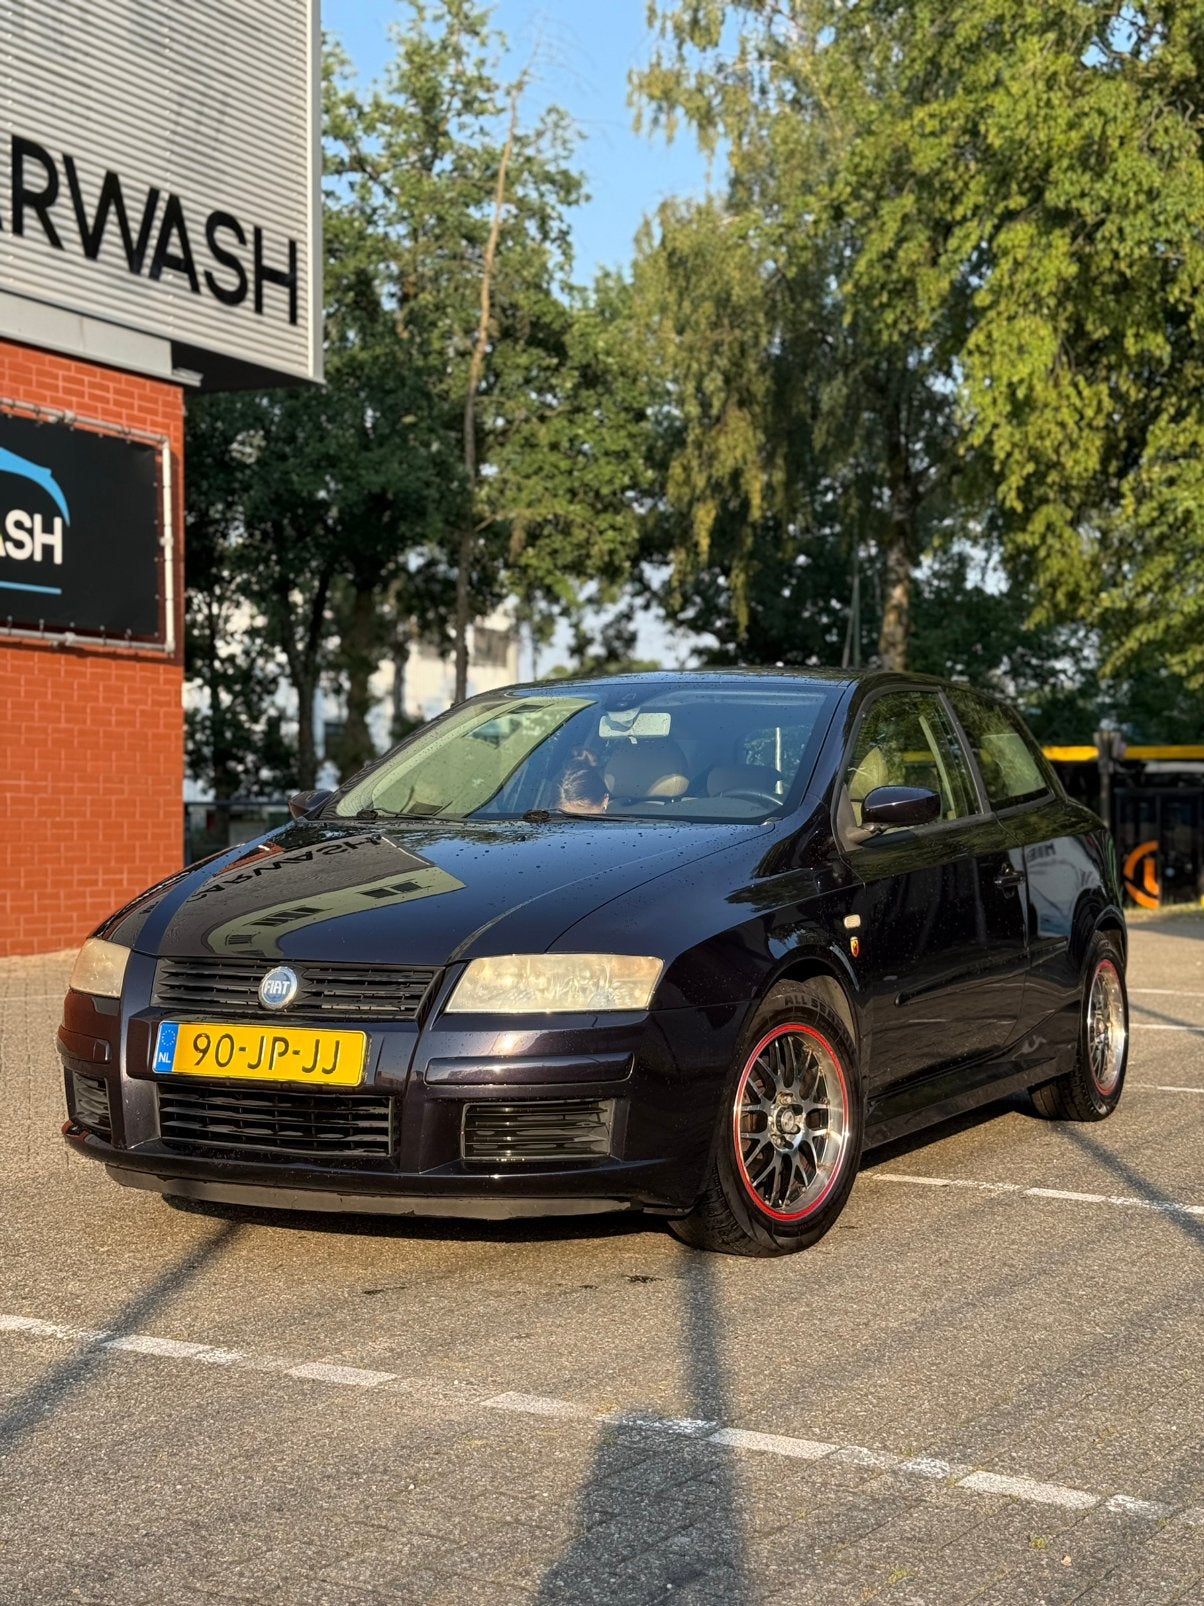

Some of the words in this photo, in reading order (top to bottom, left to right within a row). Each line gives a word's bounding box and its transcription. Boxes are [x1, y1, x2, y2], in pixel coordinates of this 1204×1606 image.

[0, 135, 298, 326] RWASH
[0, 509, 63, 565] SH
[264, 980, 290, 995] FIAT
[784, 994, 808, 1006] ALL
[158, 1052, 171, 1064] NL
[193, 1032, 340, 1075] 90-JP-JJ
